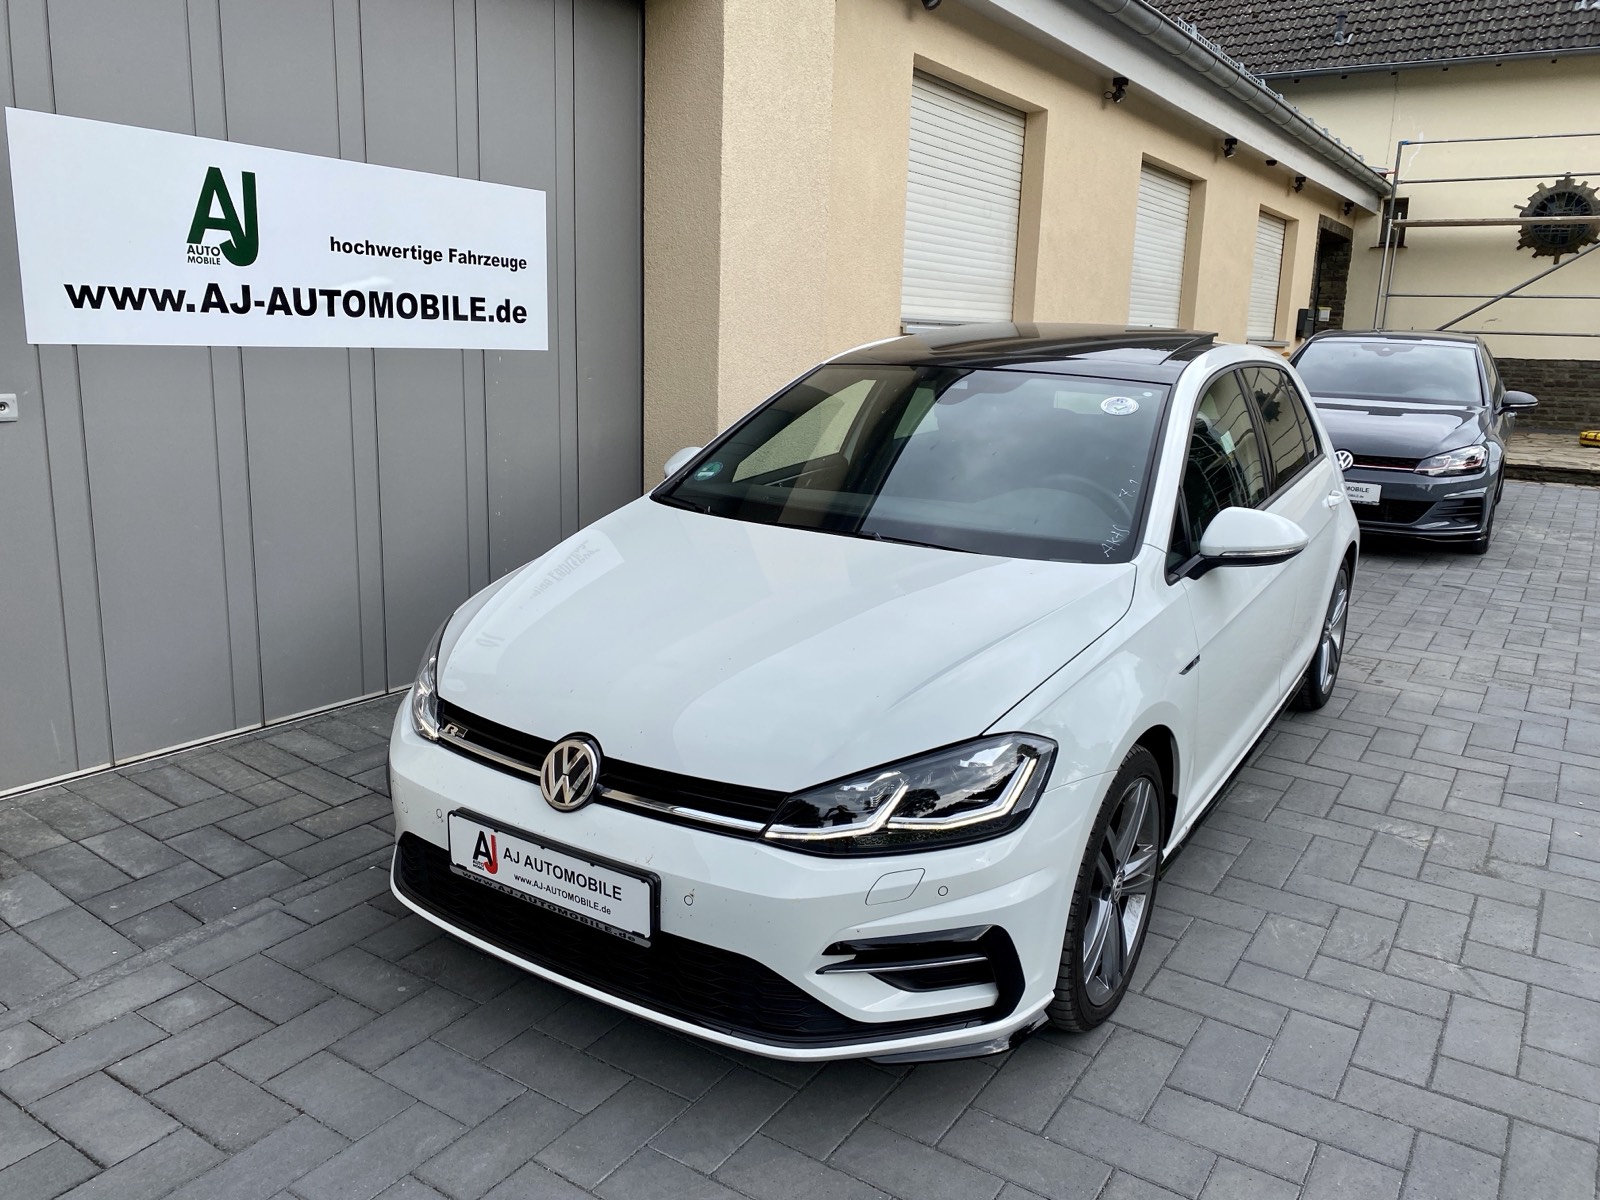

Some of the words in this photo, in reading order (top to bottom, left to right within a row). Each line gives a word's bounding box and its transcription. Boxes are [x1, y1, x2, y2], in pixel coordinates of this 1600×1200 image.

[186, 166, 259, 266] AJ
[187, 245, 220, 257] AUTO
[187, 256, 221, 266] MOBILE
[330, 236, 443, 264] hochwertige
[448, 248, 527, 271] Fahrzeuge
[64, 282, 528, 324] www.AJ-AUTOMOBILE.de
[473, 831, 498, 874] AJ
[504, 848, 520, 864] AJ
[524, 855, 622, 901] AUTOMOBILE
[514, 874, 611, 915] www.AJ-AUTOMOBILE.de
[462, 872, 636, 942] www.AJ-AUTOMOBILE.de
